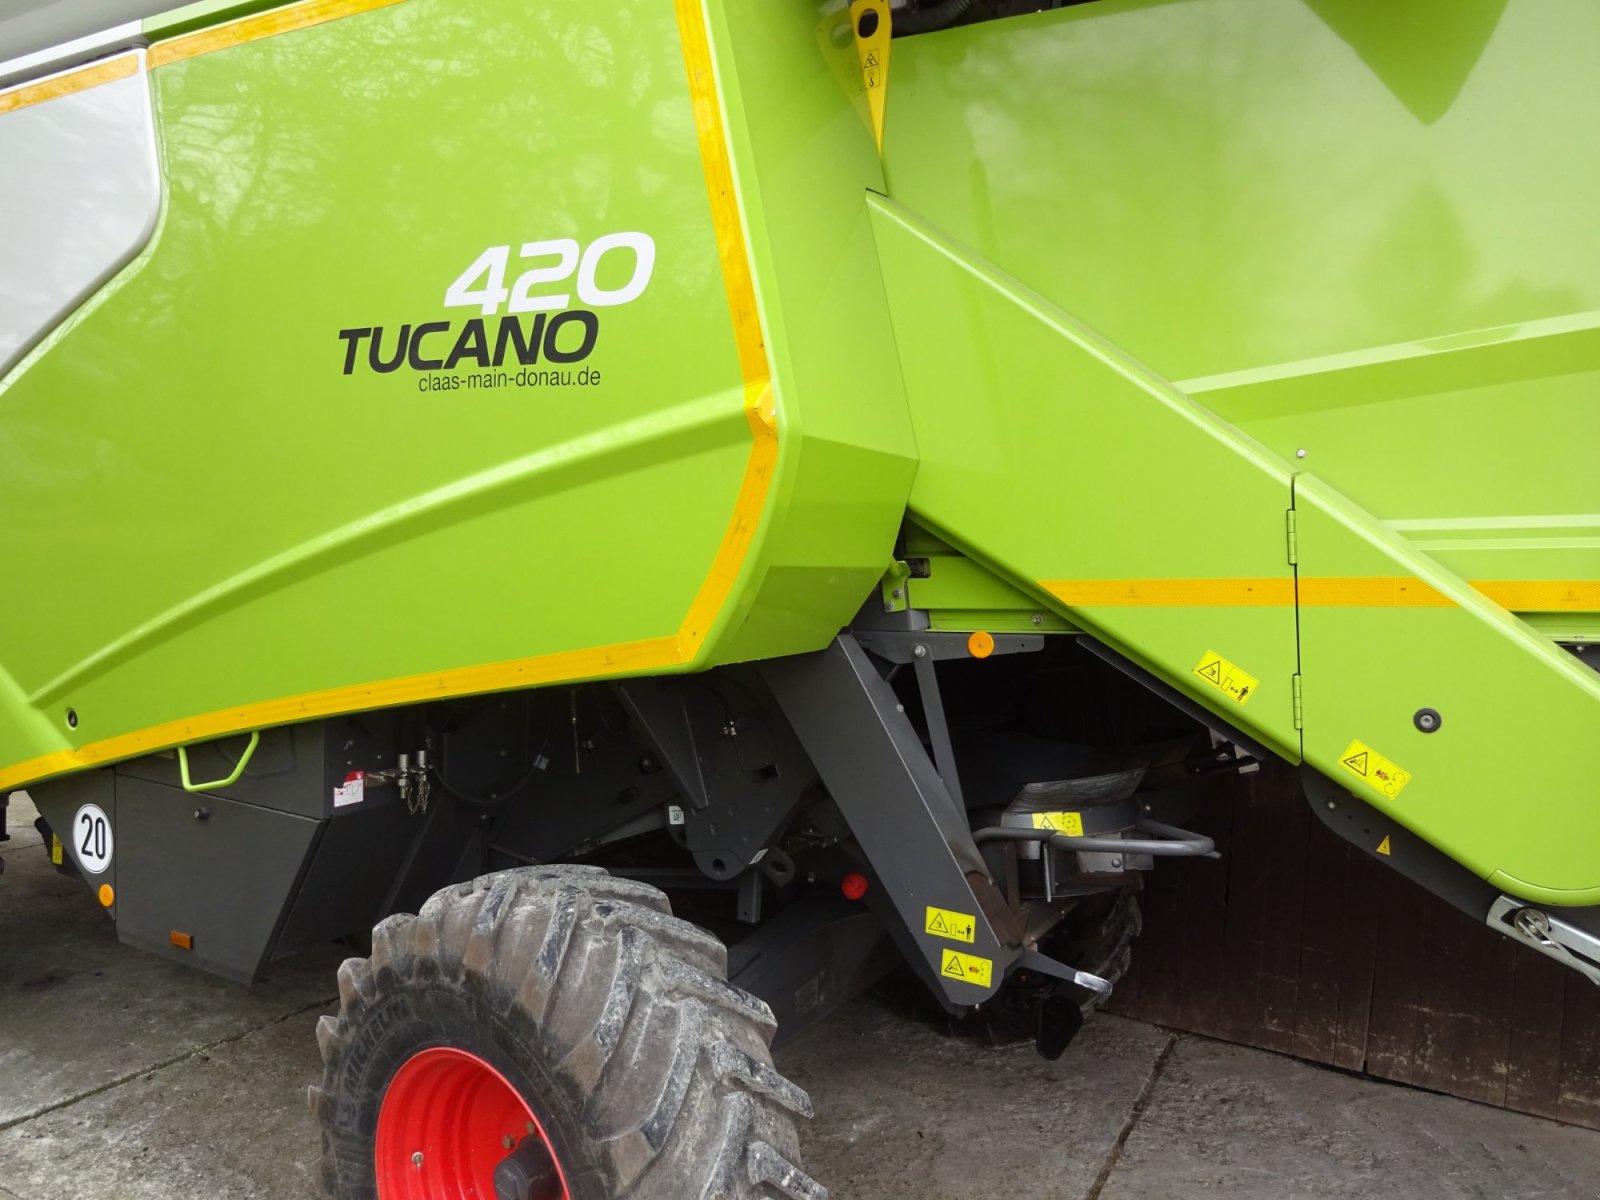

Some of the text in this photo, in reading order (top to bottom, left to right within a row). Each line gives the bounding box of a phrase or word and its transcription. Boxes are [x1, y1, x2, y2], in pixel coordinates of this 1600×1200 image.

[444, 231, 656, 315] 420
[338, 309, 599, 375] TUCANO
[418, 366, 601, 392] claas-main-donau.de
[81, 813, 106, 860] 20
